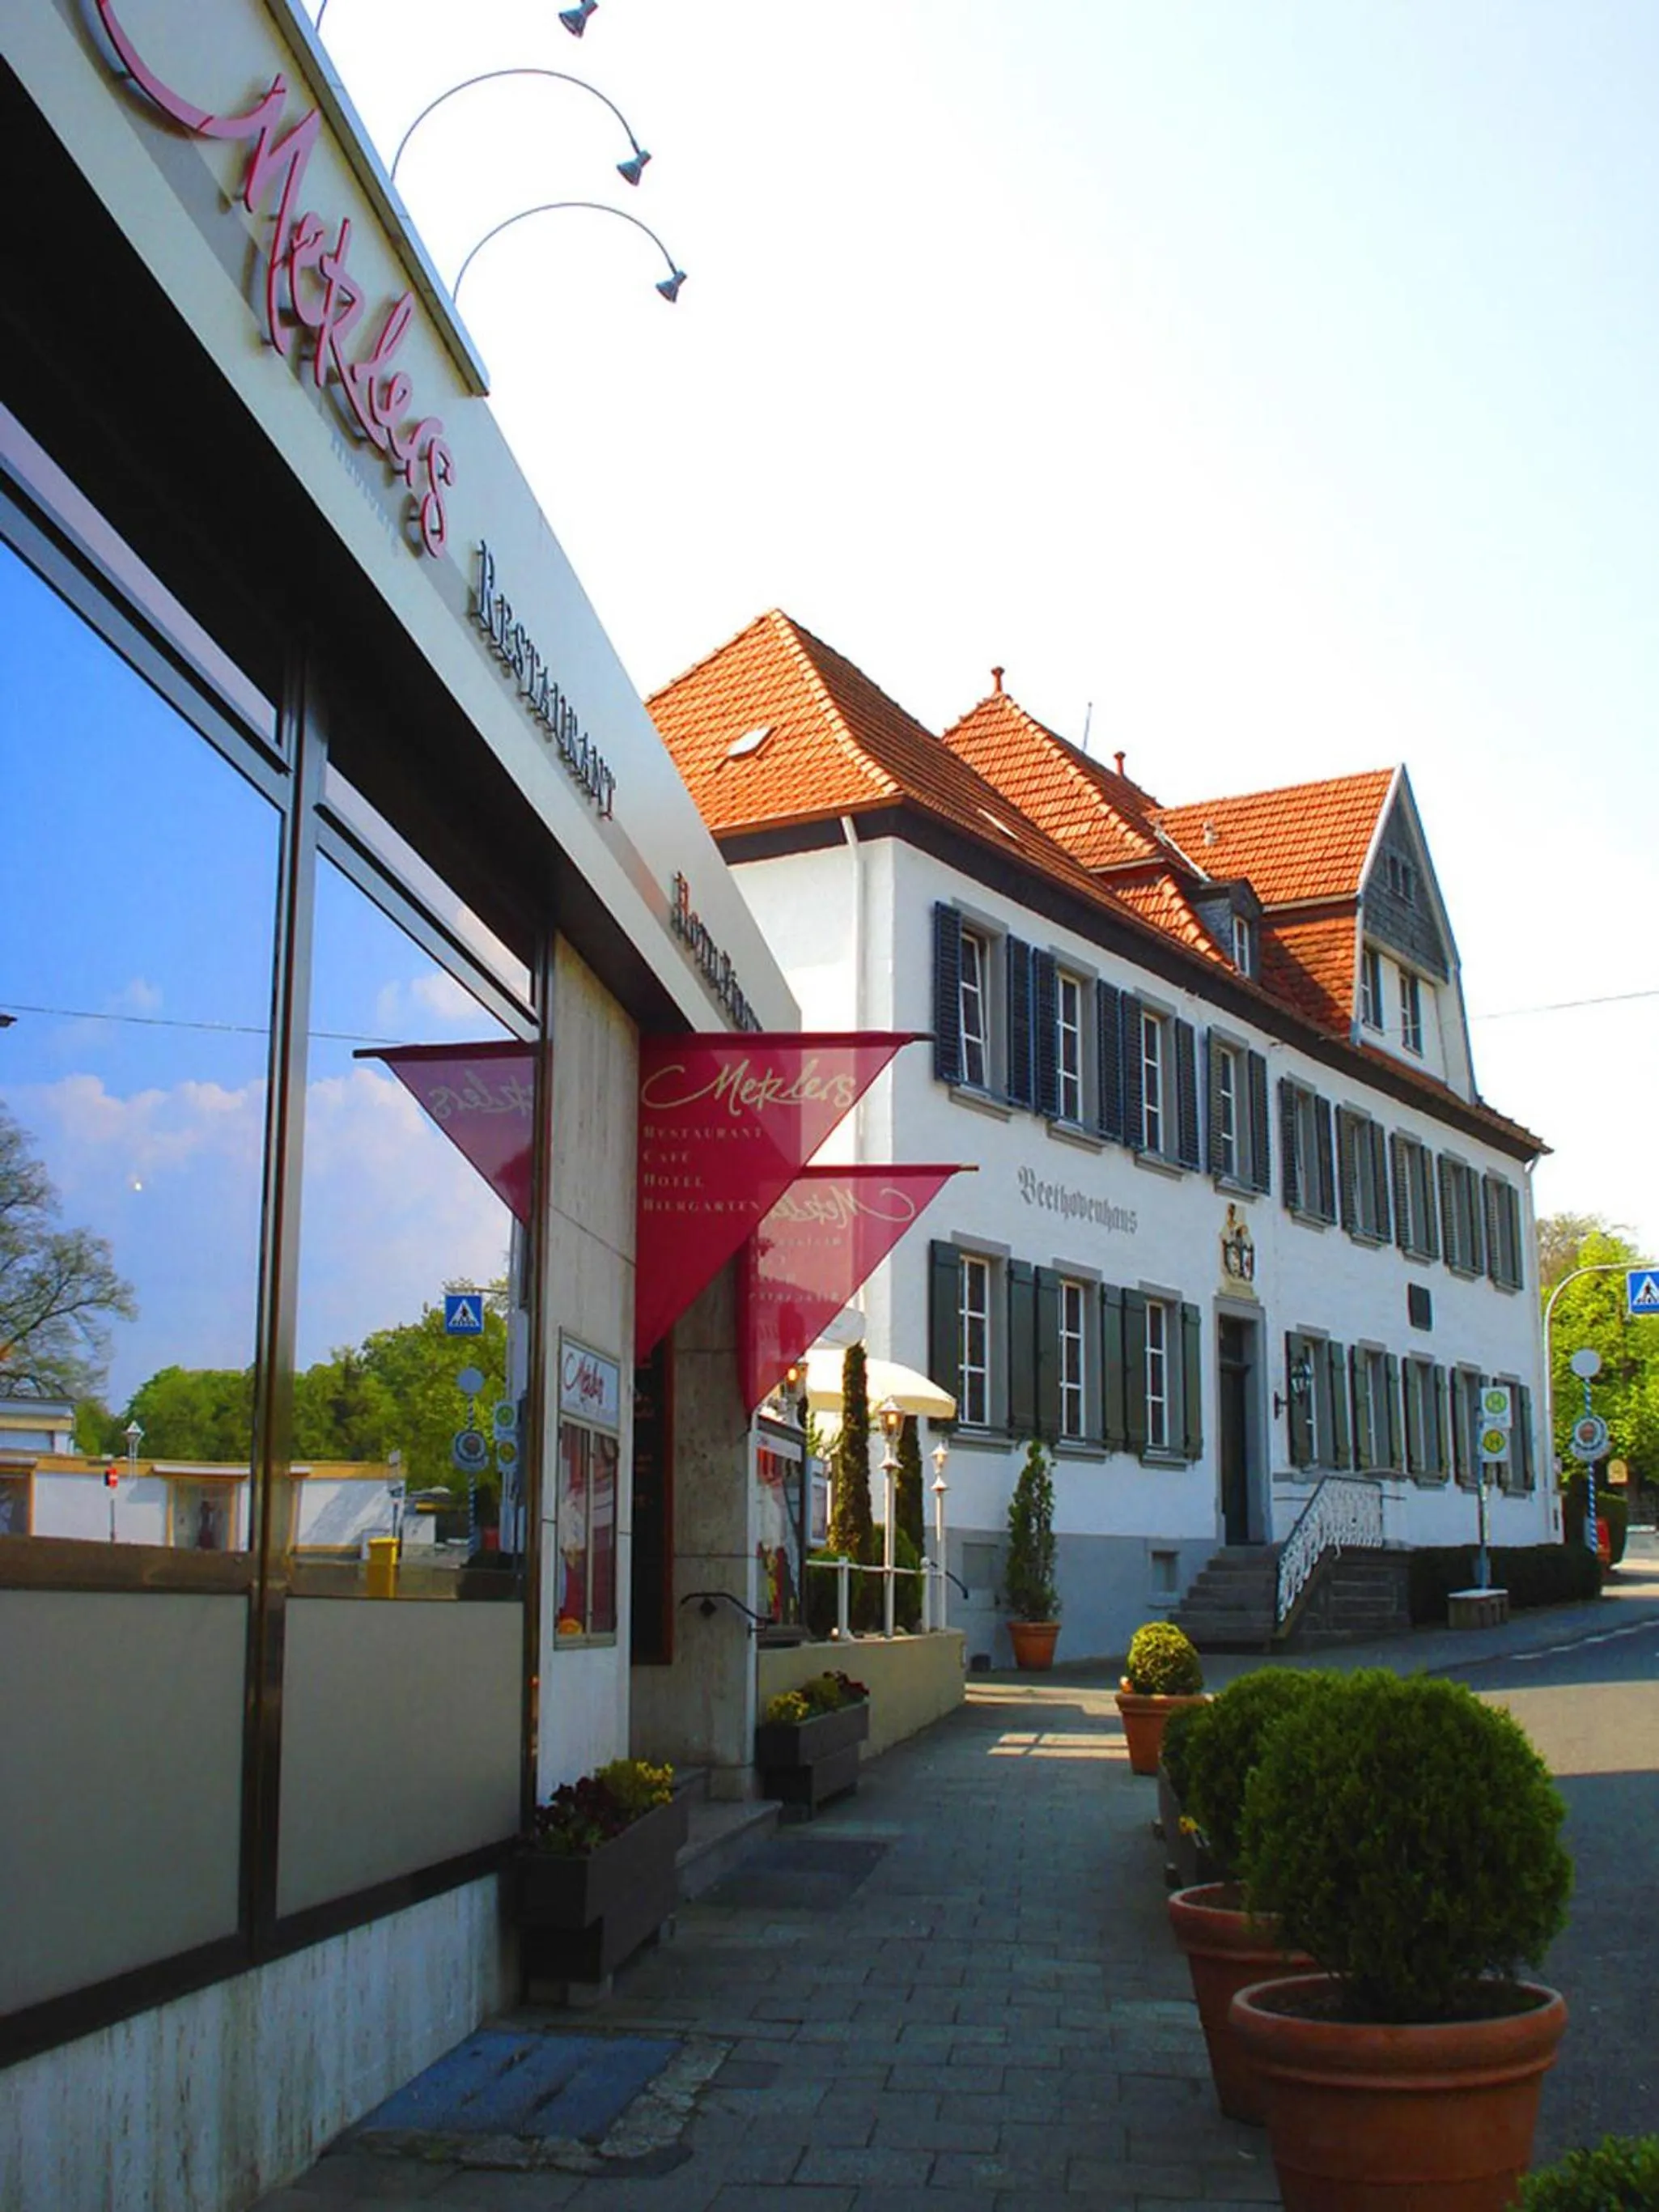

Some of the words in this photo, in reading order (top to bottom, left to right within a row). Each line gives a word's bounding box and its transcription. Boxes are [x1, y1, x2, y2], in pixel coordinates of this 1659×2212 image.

[641, 1059, 858, 1115] Metzlers
[643, 1124, 762, 1140] RESTAURANT
[643, 1172, 704, 1188] HOTEL
[643, 1197, 761, 1212] BIERGARTEN
[1017, 1165, 1139, 1235] Beethovenhaus
